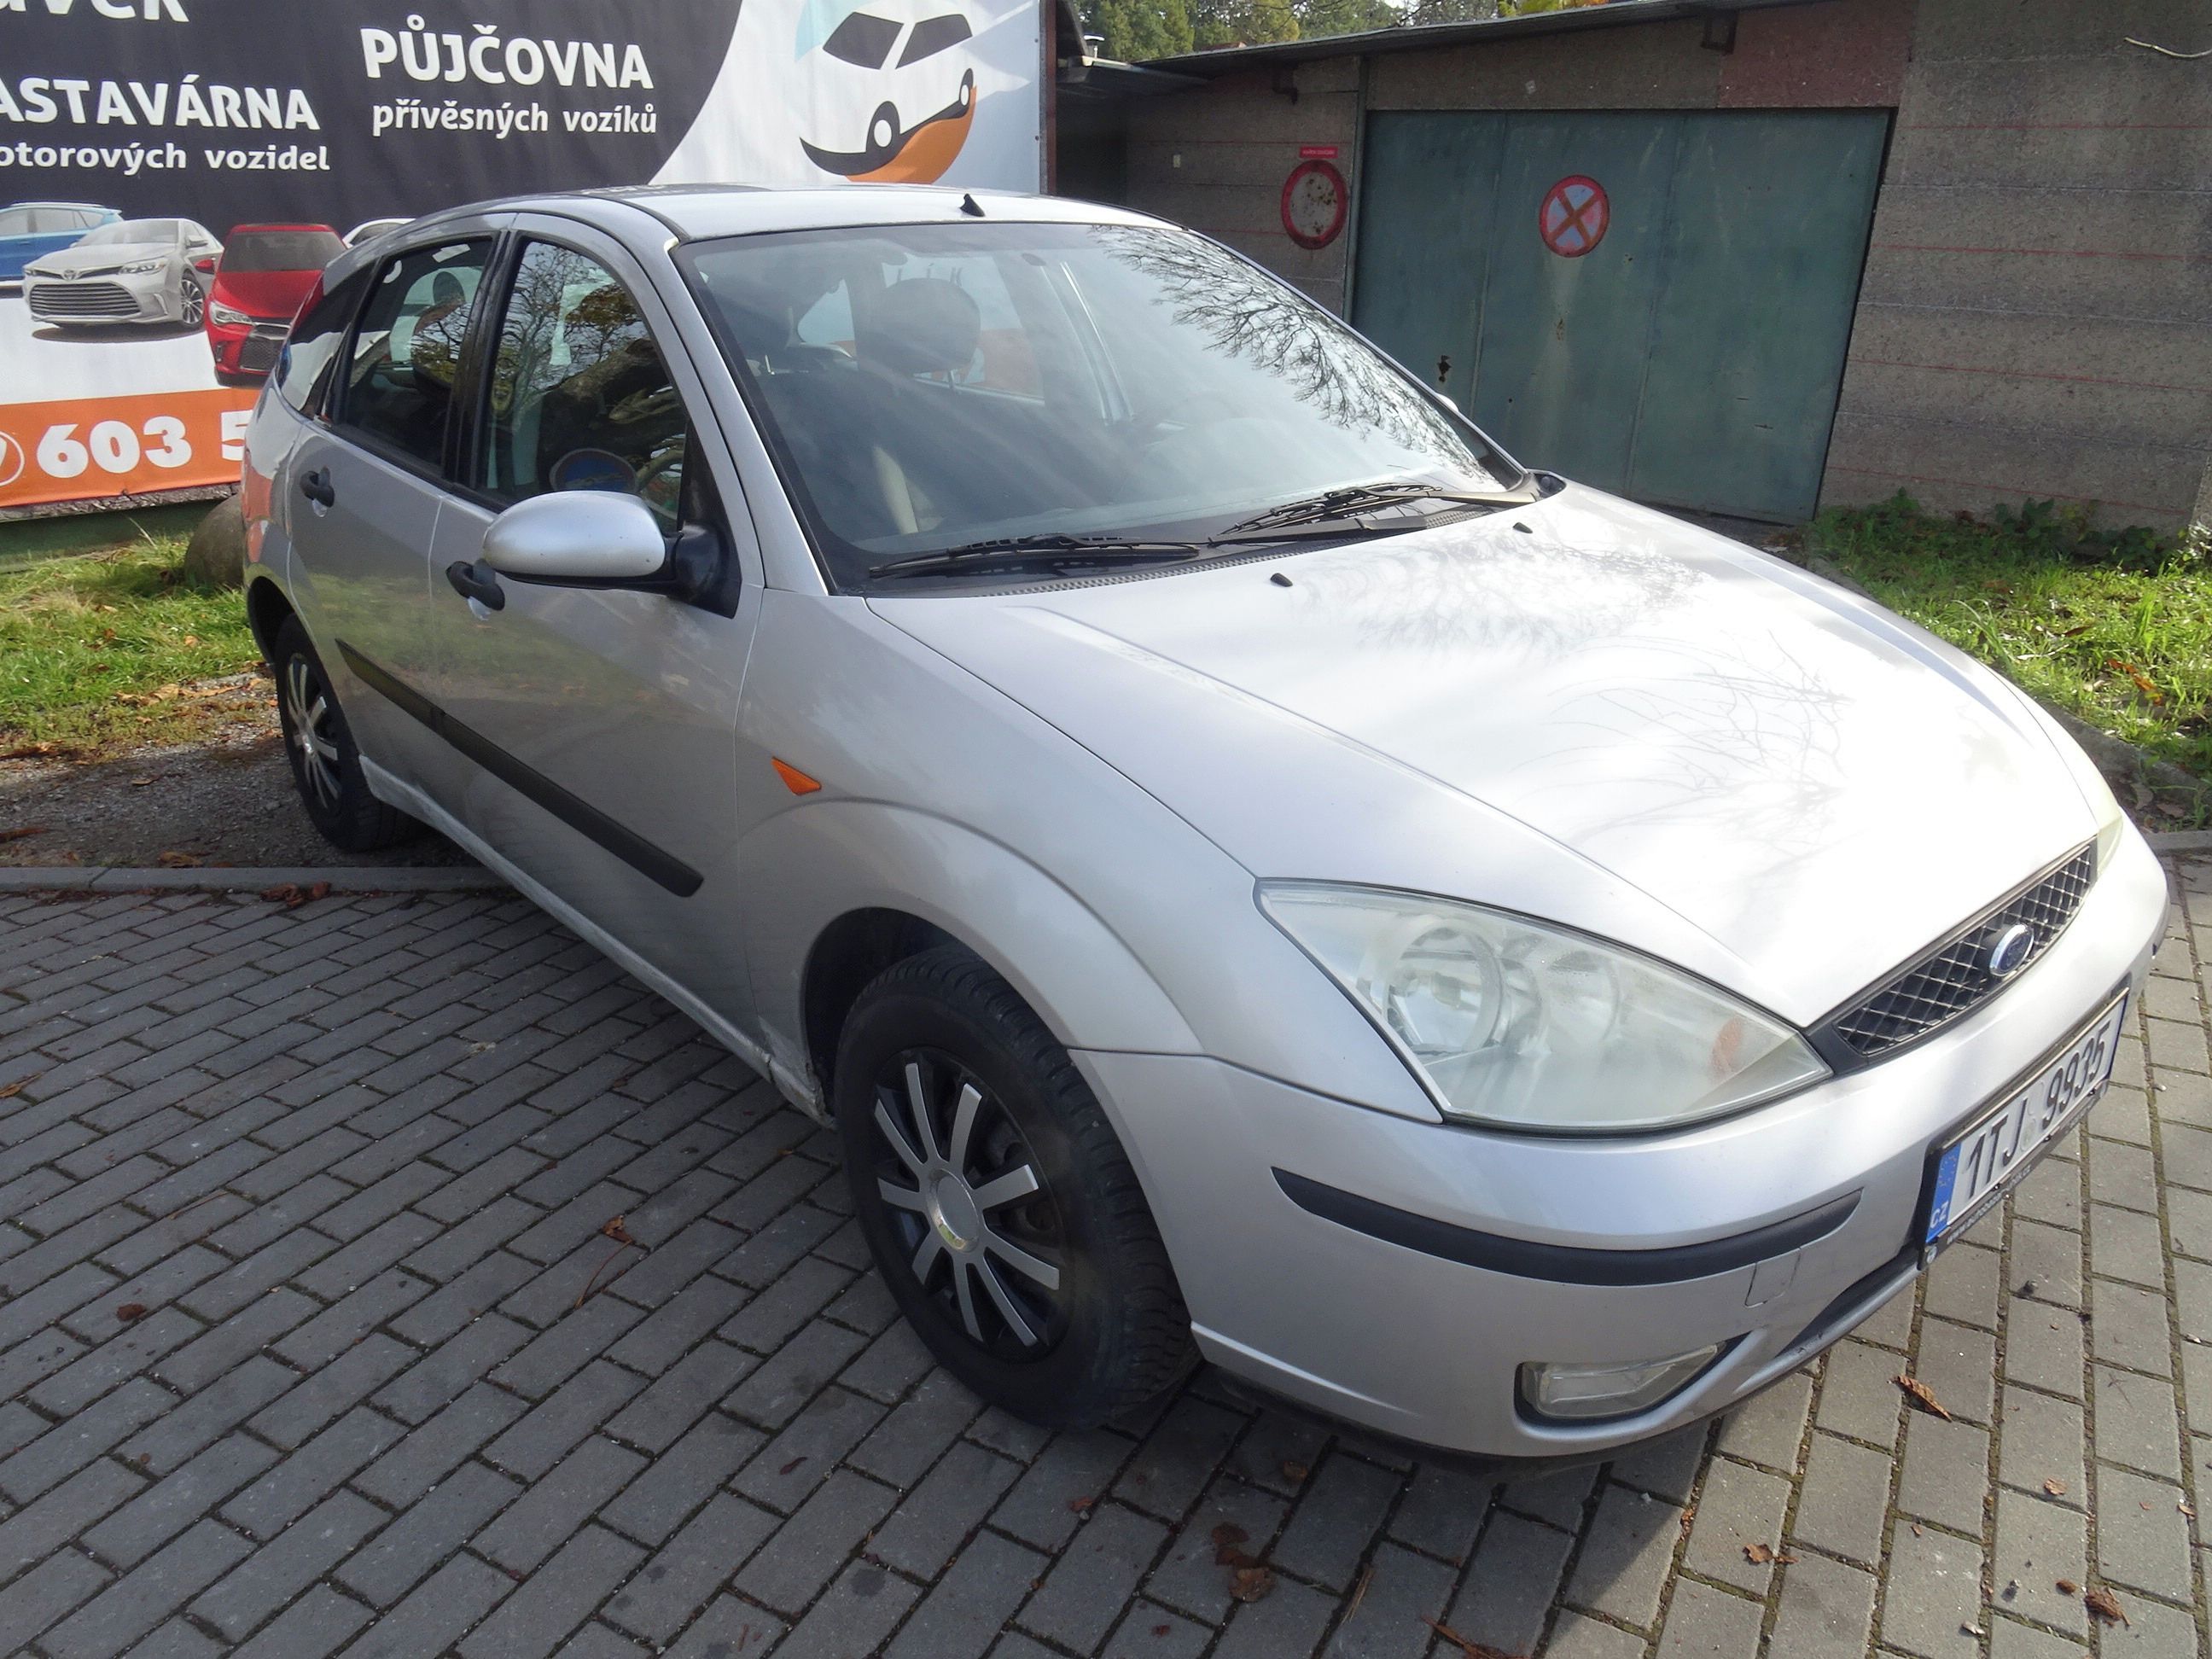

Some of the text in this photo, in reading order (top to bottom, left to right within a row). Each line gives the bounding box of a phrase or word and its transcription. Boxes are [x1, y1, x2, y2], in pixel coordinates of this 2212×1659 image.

[360, 15, 654, 89] PŮJČOVNA
[373, 99, 656, 139] přívěsných vozíků
[205, 144, 330, 170] vozidel
[37, 416, 192, 478] 603
[1965, 1020, 2111, 1199] 1TJ 9935
[1930, 1200, 1949, 1228] CZ
